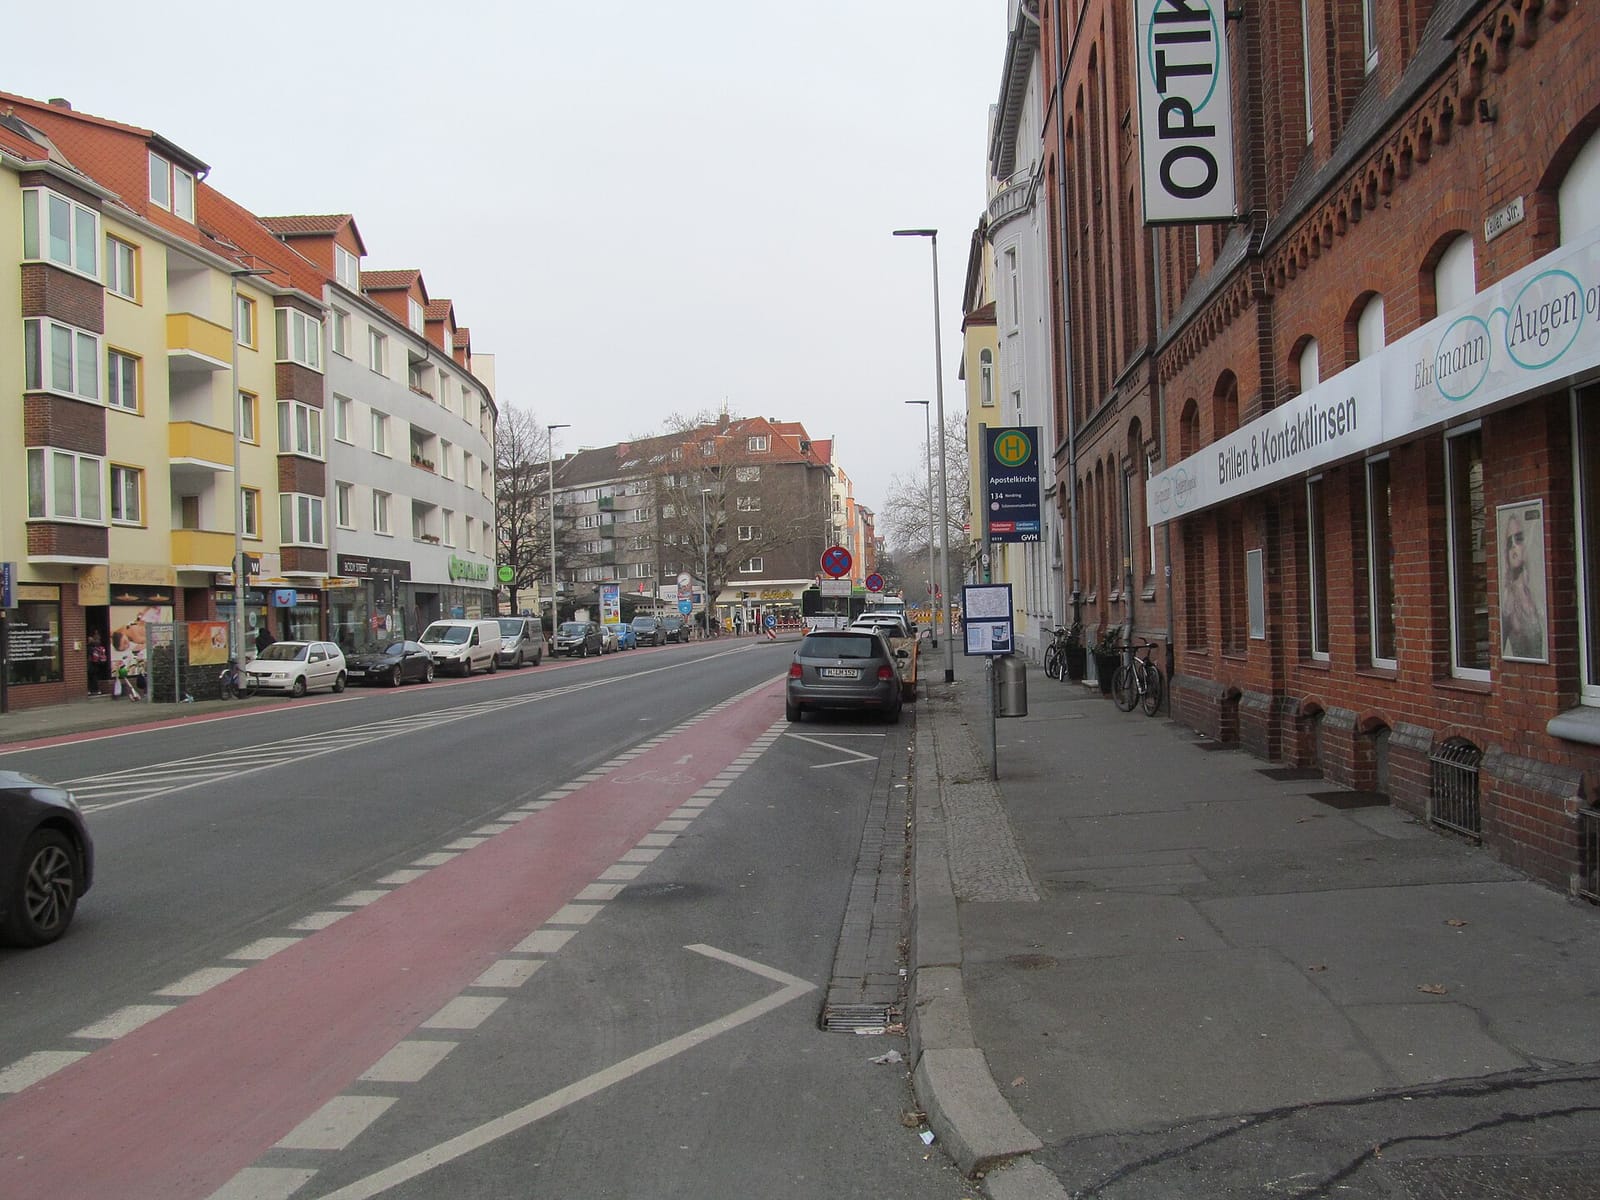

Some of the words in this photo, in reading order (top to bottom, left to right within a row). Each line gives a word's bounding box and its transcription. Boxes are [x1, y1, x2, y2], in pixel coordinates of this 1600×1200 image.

[1153, 0, 1218, 200] OPTIK
[1506, 203, 1520, 222] Str.
[1218, 444, 1249, 486] Brillen
[1251, 434, 1260, 472] &
[1261, 396, 1357, 468] Kontaktlinsen
[990, 475, 1037, 485] Apostelkirche
[991, 492, 1004, 500] 134
